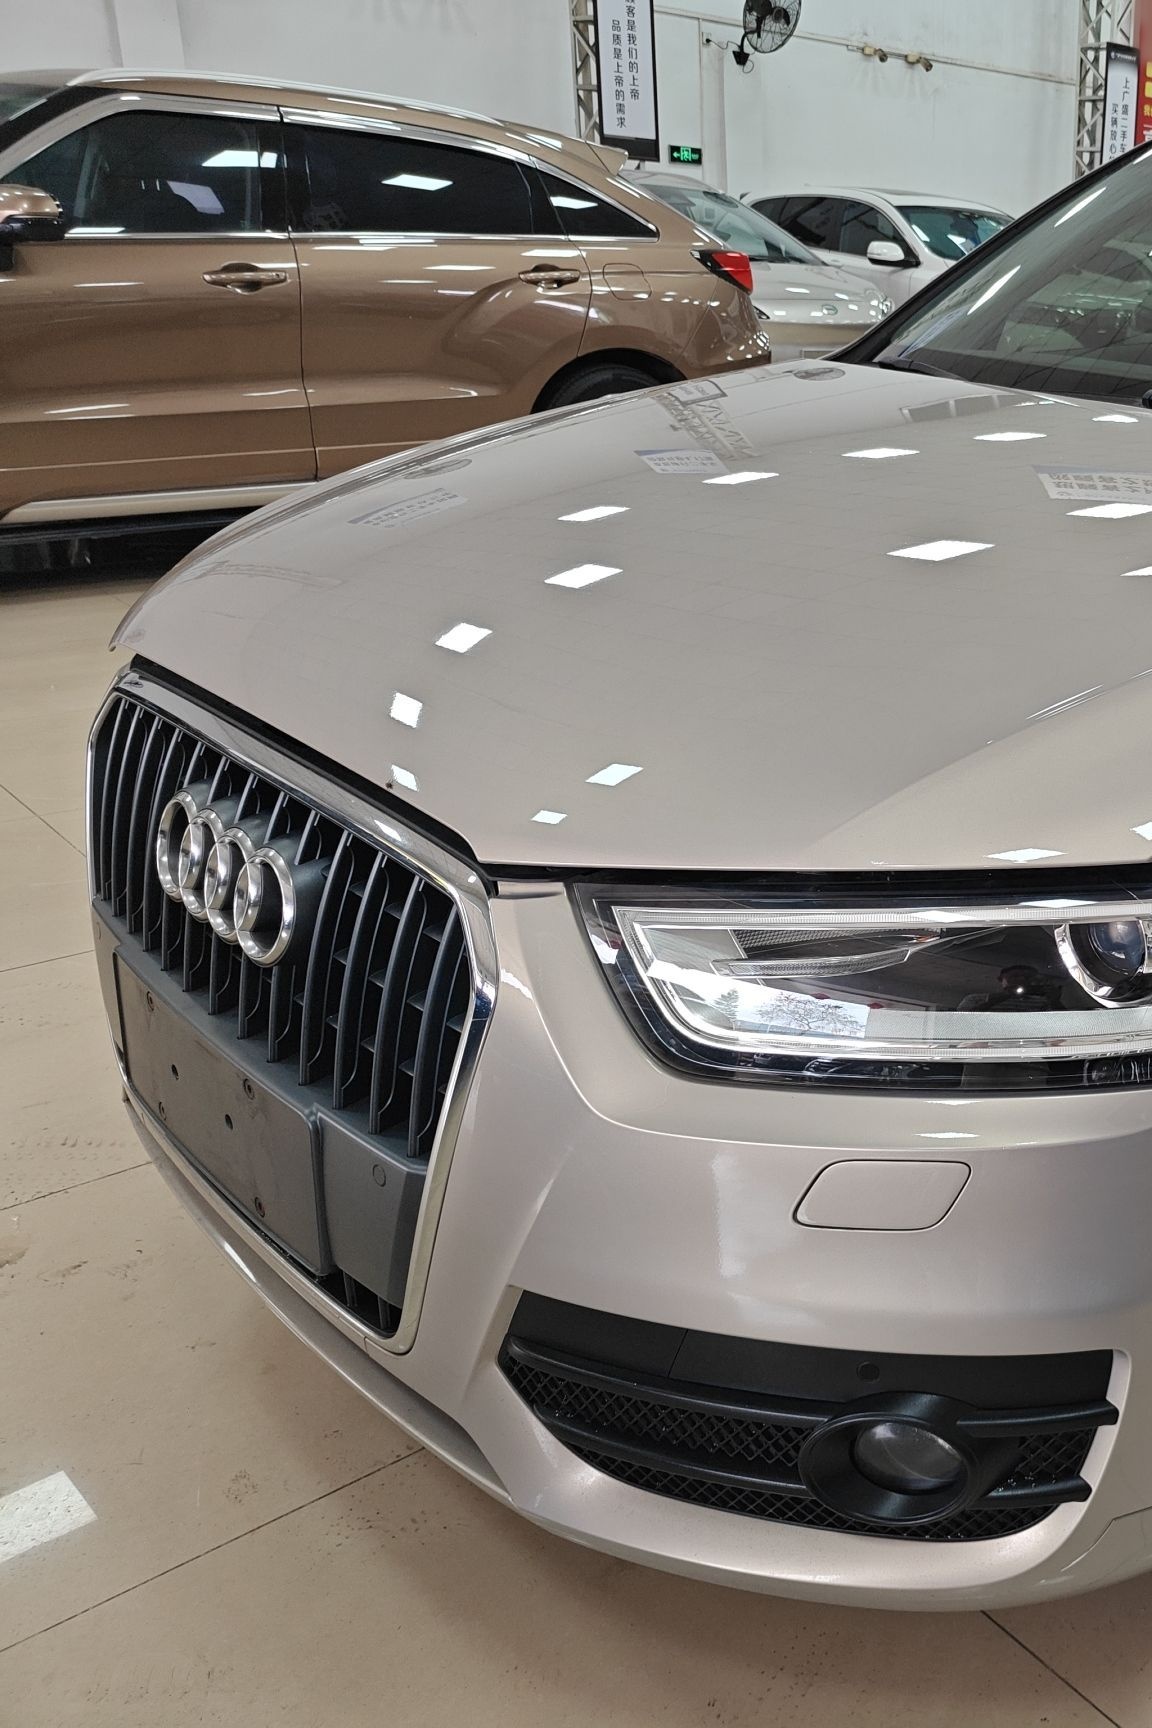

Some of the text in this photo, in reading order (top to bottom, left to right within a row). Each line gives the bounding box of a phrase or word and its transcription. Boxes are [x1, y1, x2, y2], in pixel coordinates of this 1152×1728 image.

[611, 19, 628, 129] 品质是上帝的需求
